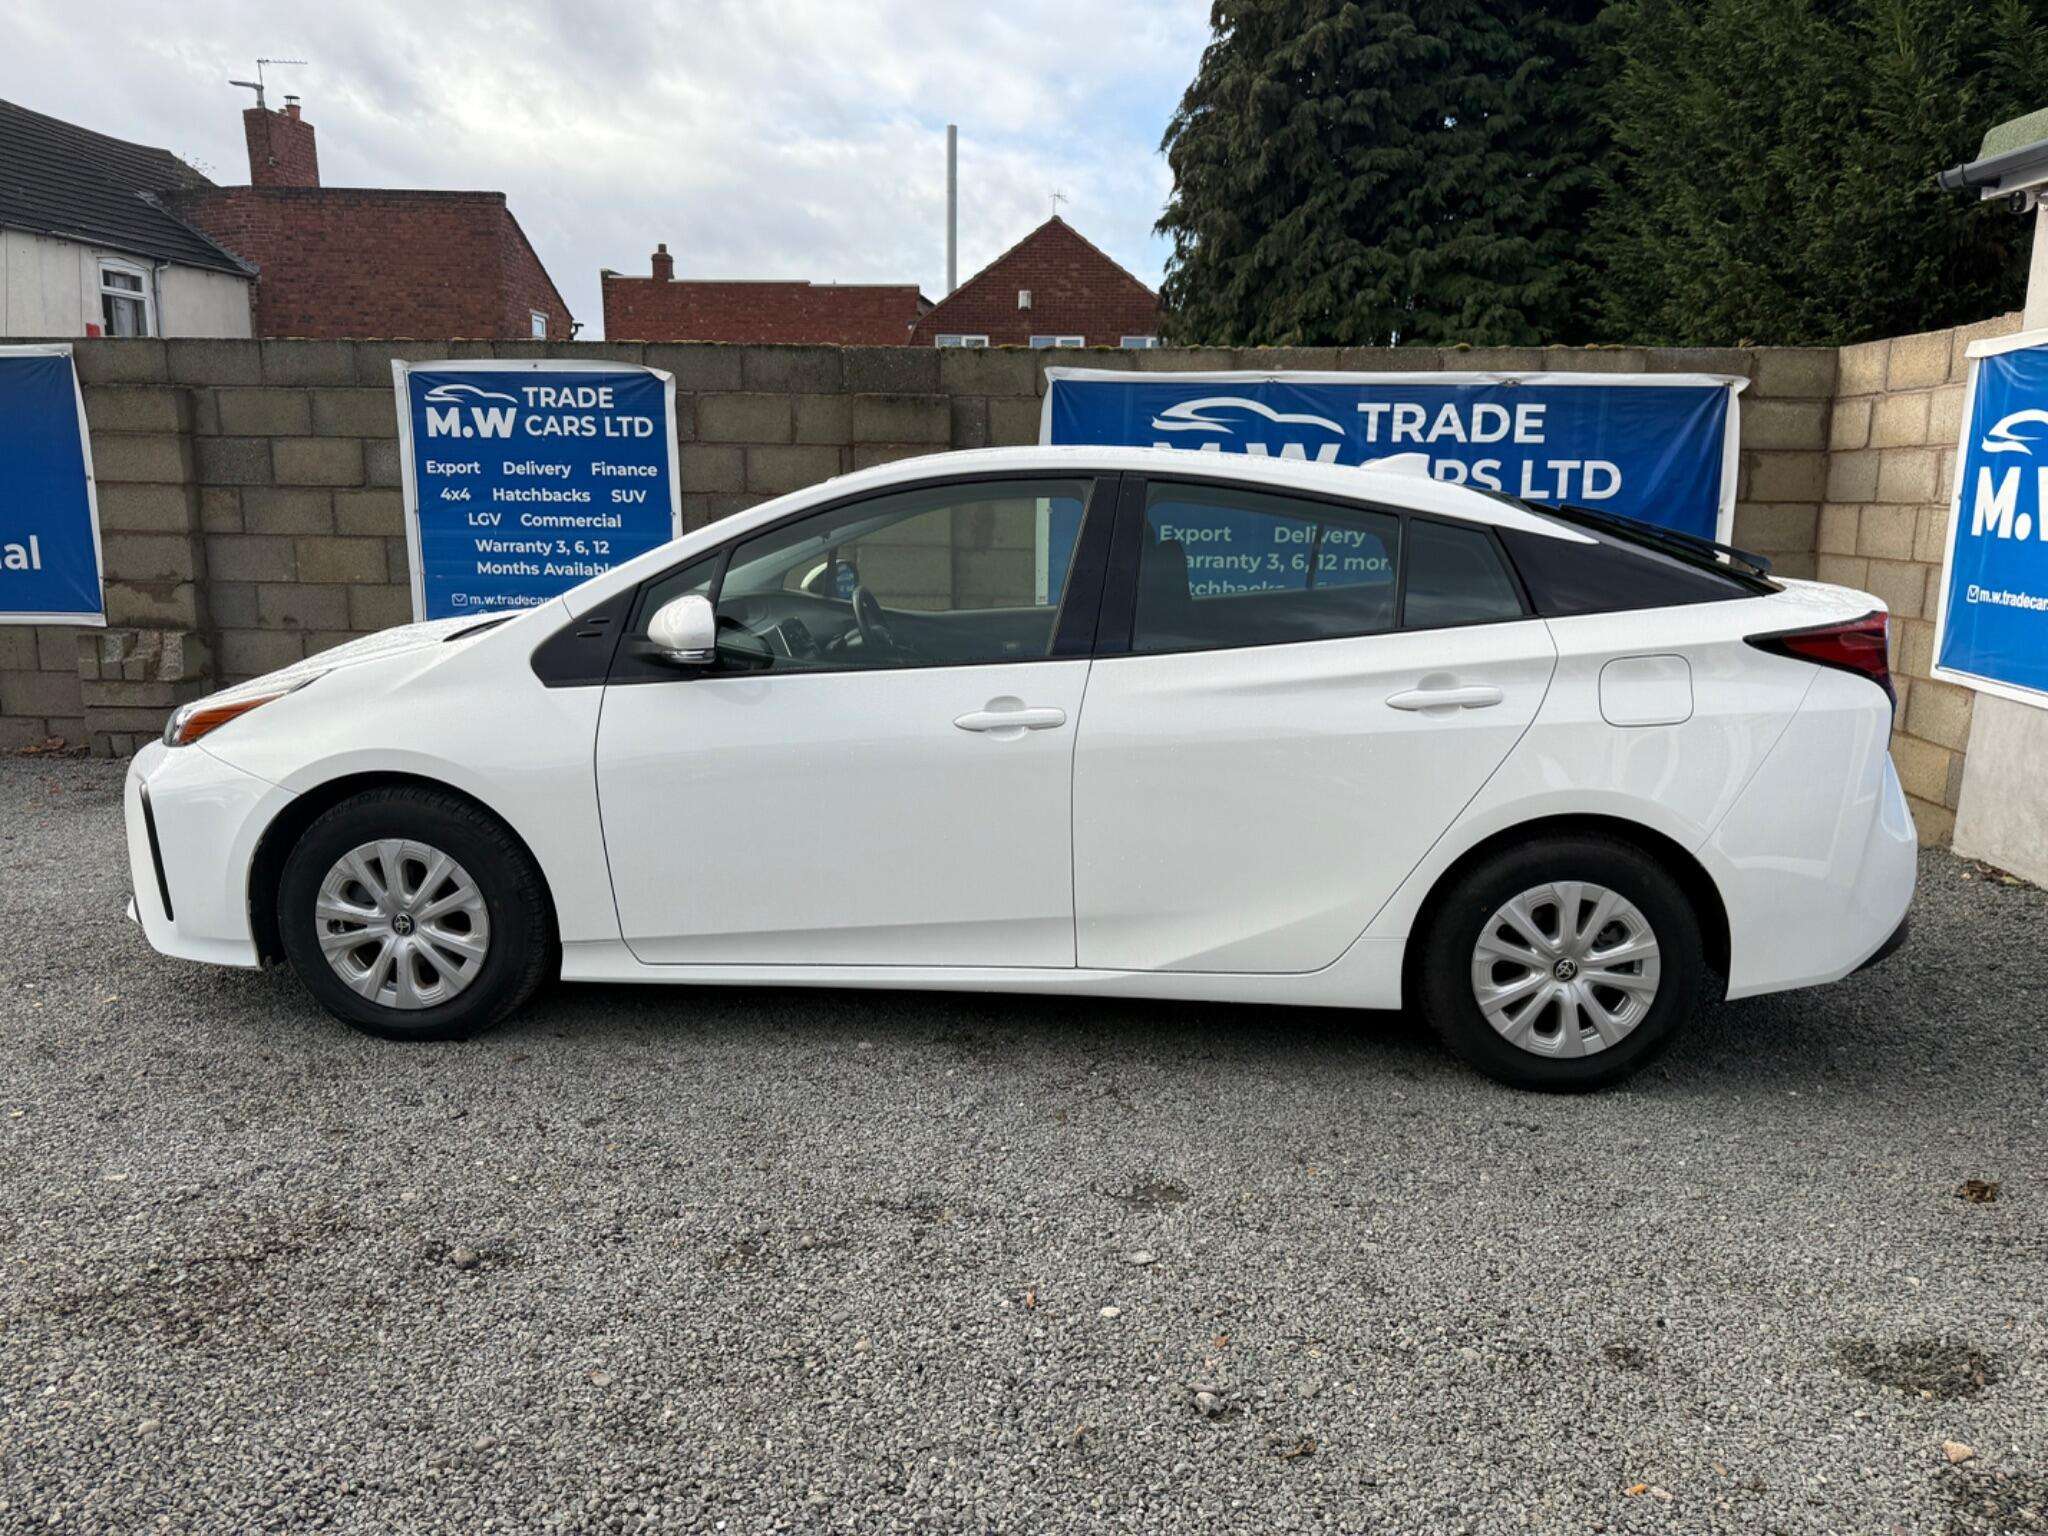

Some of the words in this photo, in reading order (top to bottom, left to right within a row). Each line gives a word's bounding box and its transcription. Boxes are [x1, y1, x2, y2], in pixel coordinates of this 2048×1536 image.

[521, 386, 615, 409] TRADE
[425, 406, 517, 438] M.W
[524, 415, 597, 437] CARS
[604, 416, 654, 437] LTD
[1357, 402, 1547, 444] TRADE
[426, 460, 481, 477] Export
[503, 461, 572, 478] Delivery
[591, 461, 658, 477] Finance
[1519, 459, 1622, 500] LTD
[440, 488, 471, 501] 4x4
[492, 488, 591, 503] Hatchbacks
[611, 489, 646, 503] SUV
[468, 512, 501, 527] LGV
[520, 513, 622, 529] Commercial
[1160, 525, 1232, 545] Export
[475, 539, 552, 556] Warranty
[556, 540, 570, 556] 3,
[574, 540, 589, 556] 6,
[592, 540, 610, 554] 12
[477, 561, 540, 576] Months
[544, 562, 615, 577] Availabl
[1186, 554, 1261, 573] arranty
[1267, 554, 1285, 572] 3,
[1291, 554, 1309, 573] 6,
[1318, 554, 1337, 570] 12
[1980, 589, 2048, 611] m.w.tradecar
